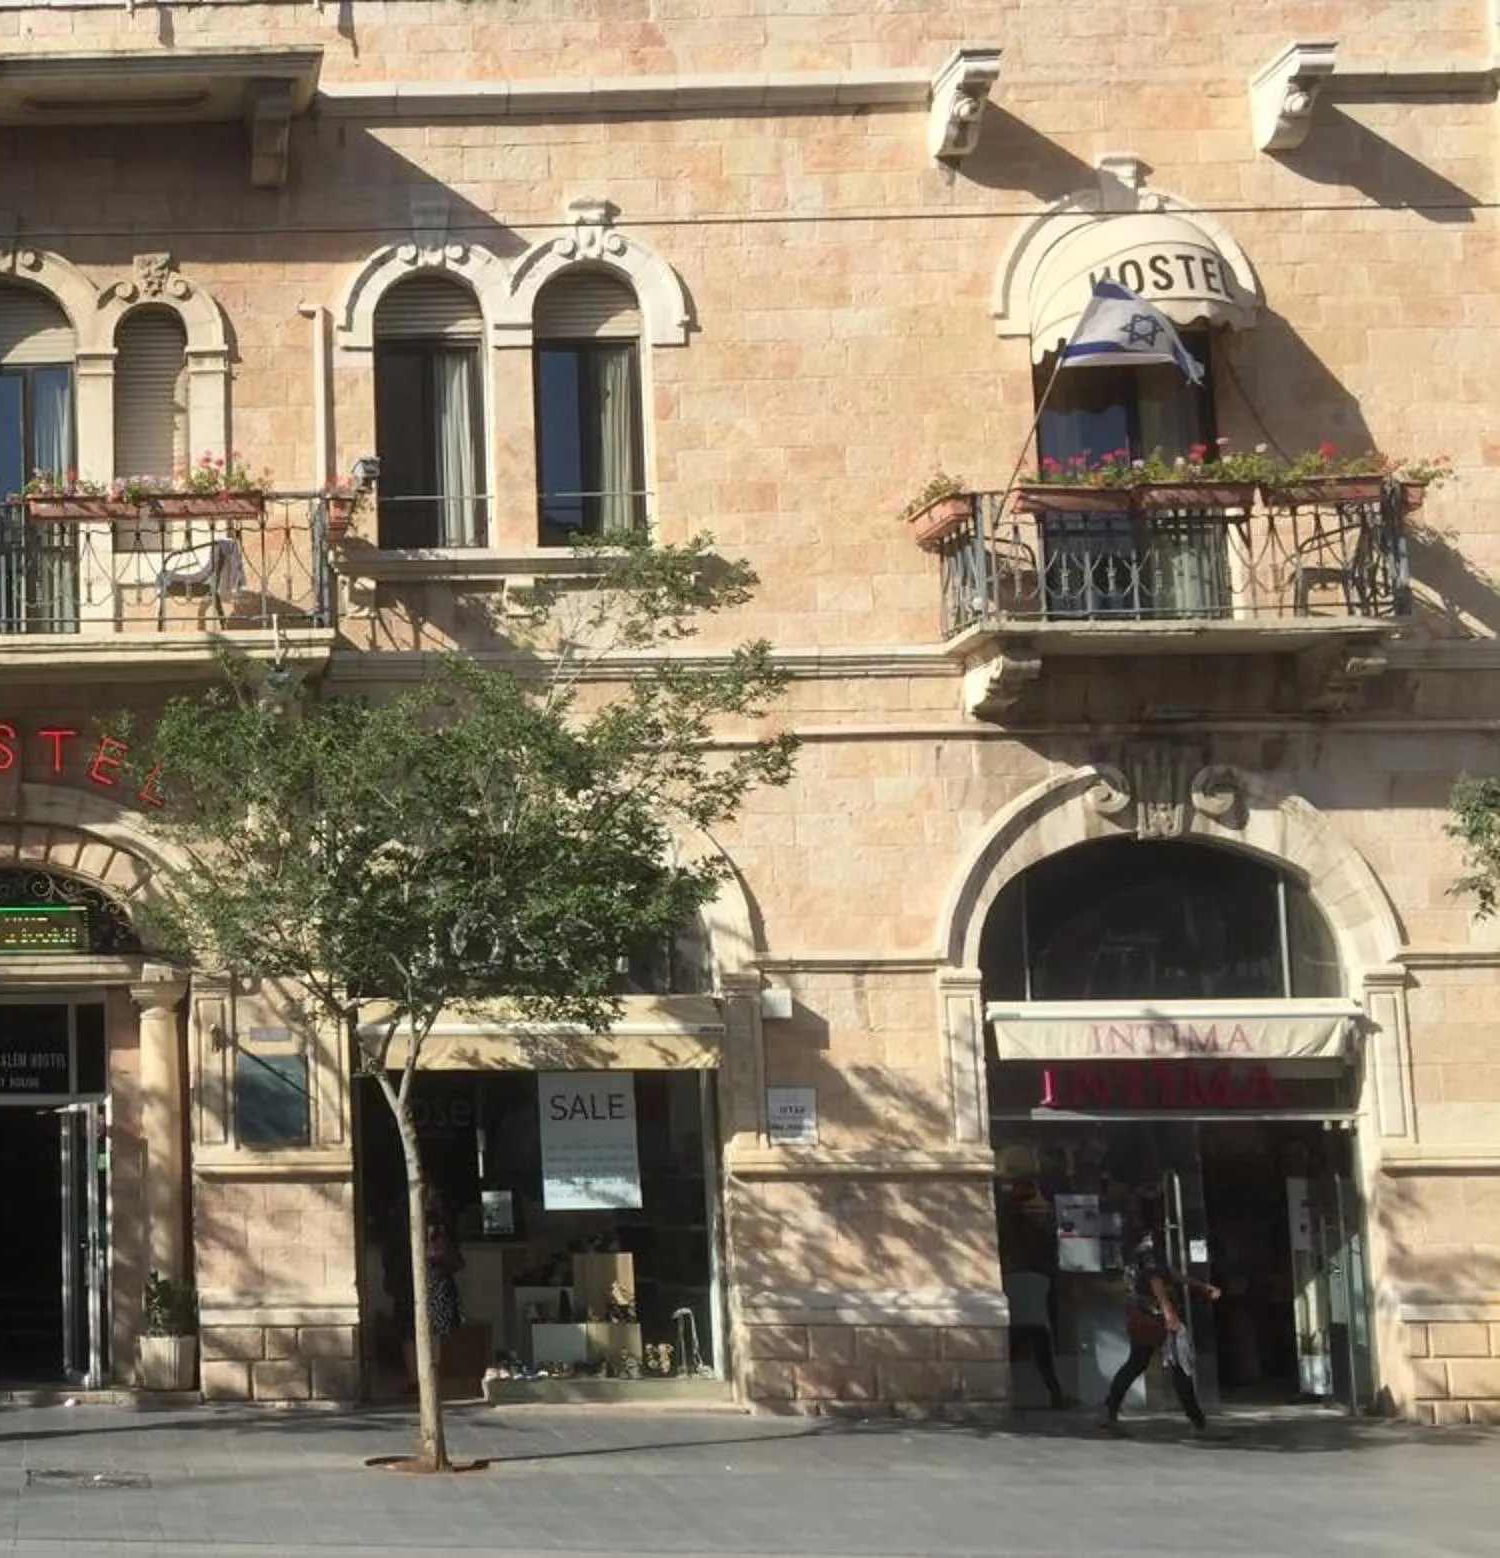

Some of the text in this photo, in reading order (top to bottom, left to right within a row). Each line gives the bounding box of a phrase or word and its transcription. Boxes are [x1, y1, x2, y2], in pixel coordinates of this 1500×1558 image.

[1088, 1023, 1254, 1053] INTIMA
[1040, 1063, 1290, 1107] INTIMA
[550, 1094, 626, 1121] SALE
